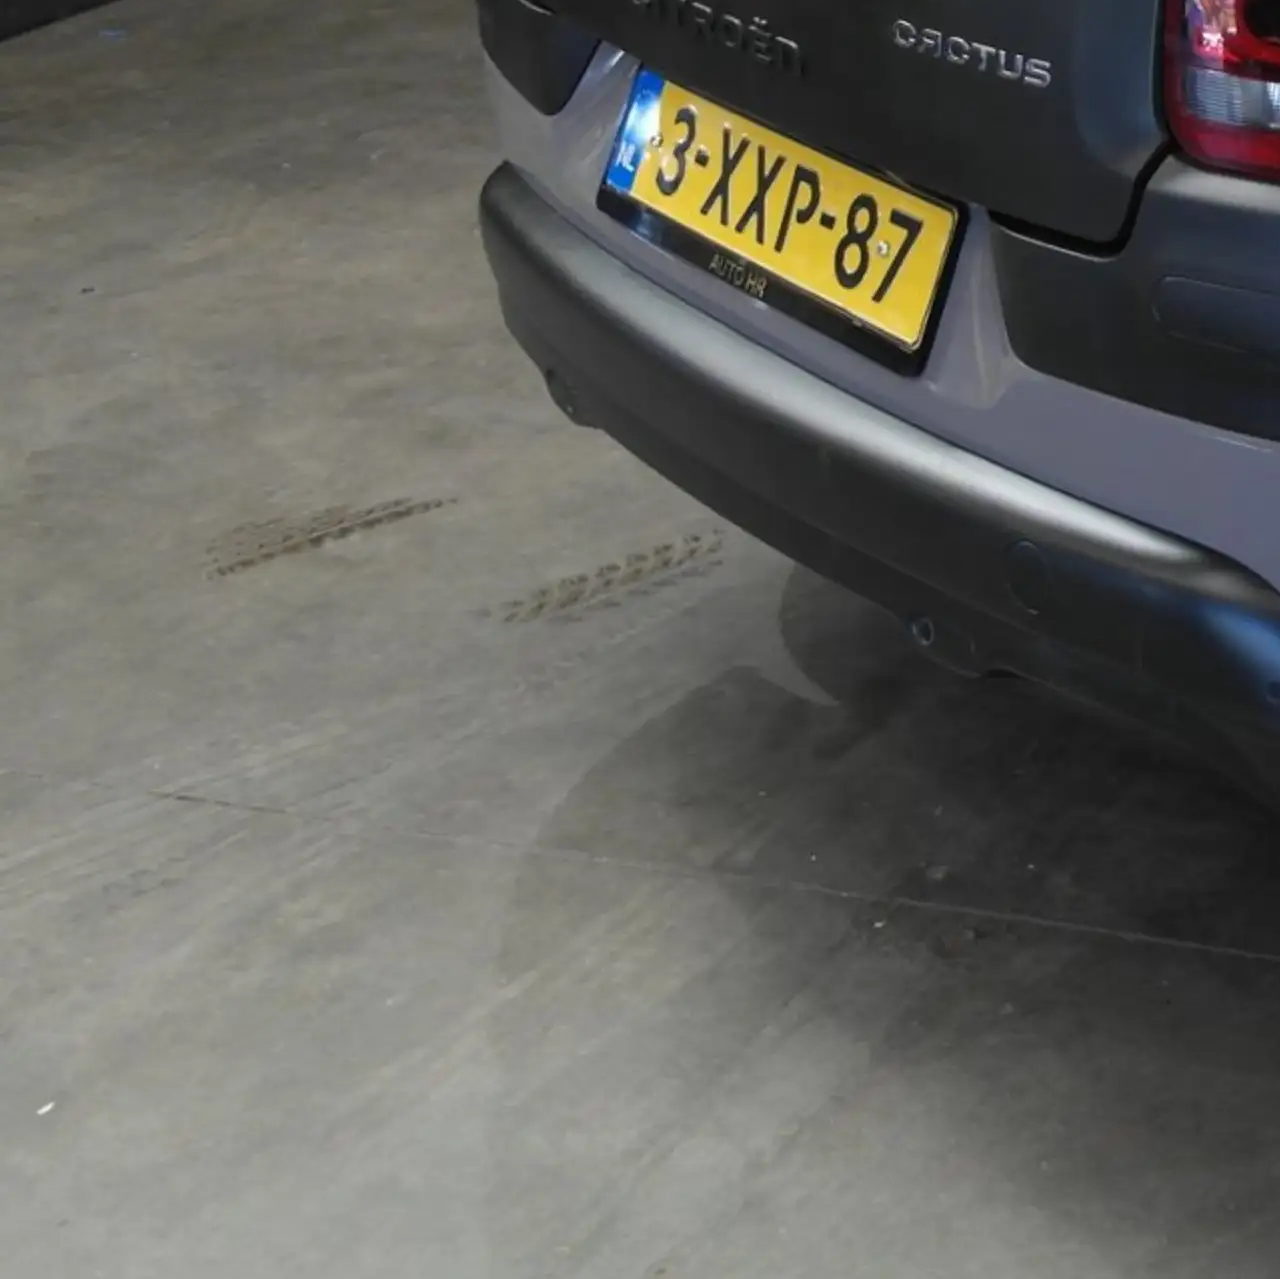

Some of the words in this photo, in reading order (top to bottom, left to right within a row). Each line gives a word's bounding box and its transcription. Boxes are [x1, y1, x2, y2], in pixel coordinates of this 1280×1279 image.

[893, 19, 1053, 88] CACTUS
[654, 103, 924, 304] 3-XXP-87
[707, 252, 746, 287] AUTO
[744, 270, 769, 299] HR
